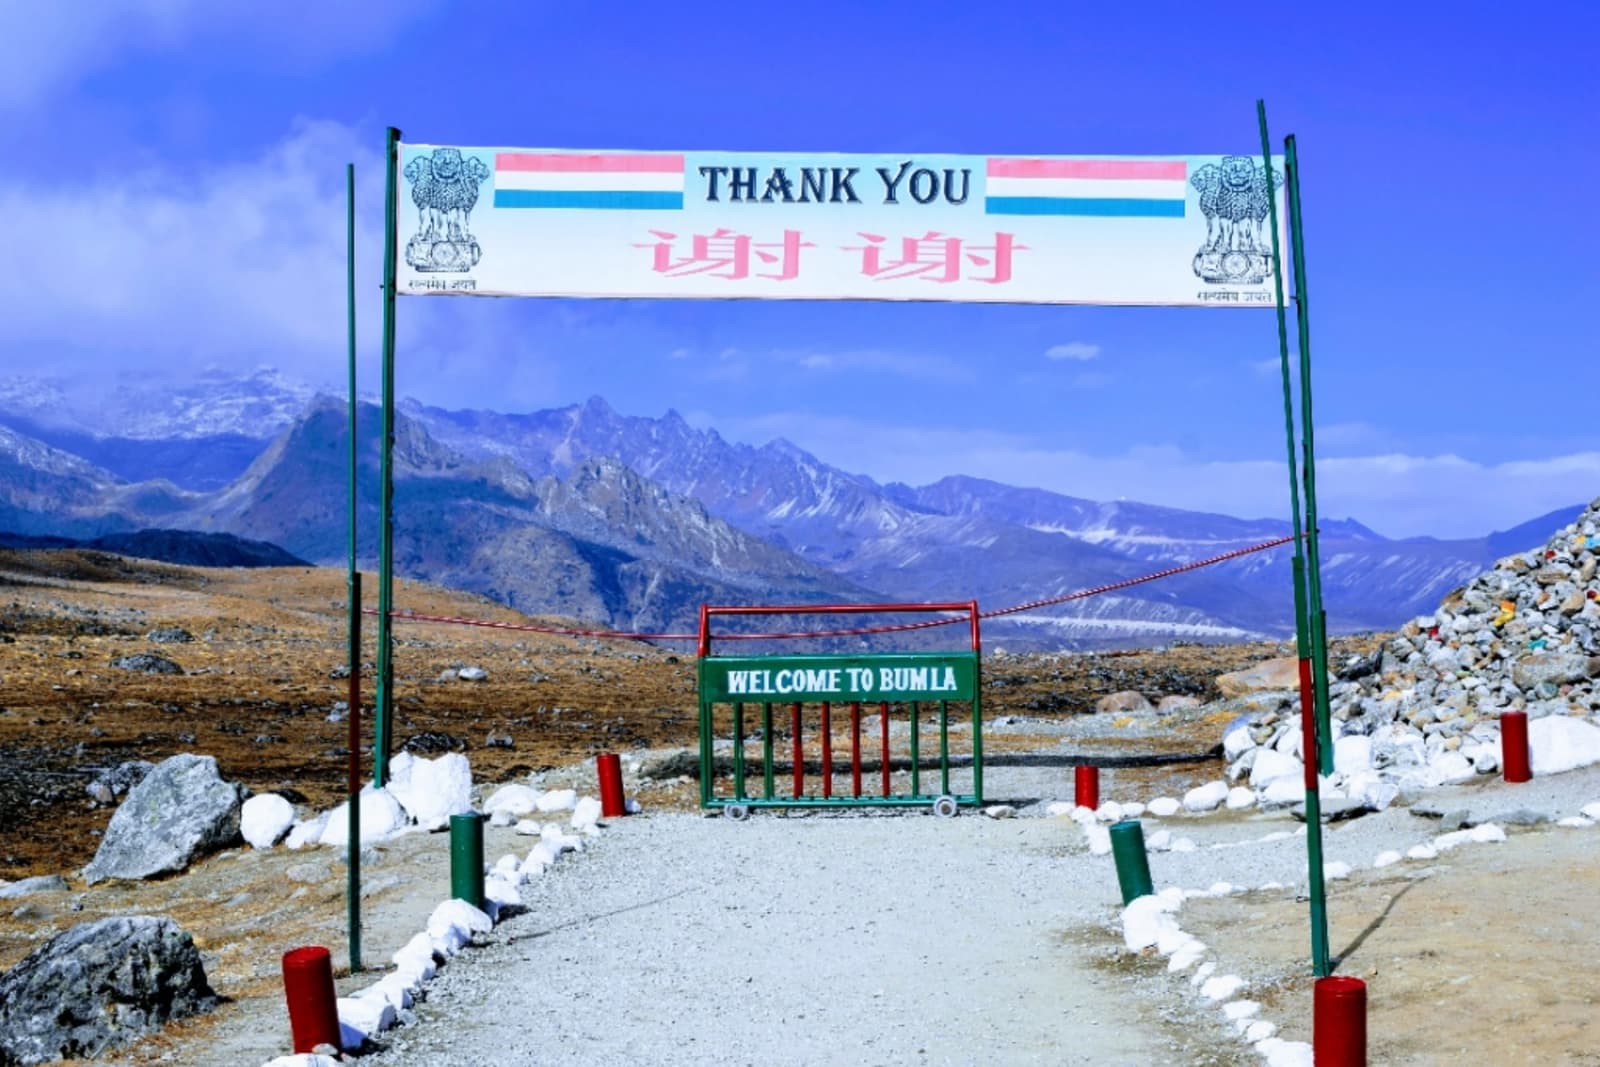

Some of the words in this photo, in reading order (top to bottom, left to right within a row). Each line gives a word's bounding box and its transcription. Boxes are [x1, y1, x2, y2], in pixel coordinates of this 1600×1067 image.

[699, 166, 863, 205] THANK
[875, 160, 972, 205] YOU
[727, 668, 841, 694] WELCOME
[846, 667, 874, 693] TO
[879, 666, 958, 692] BUMLA
